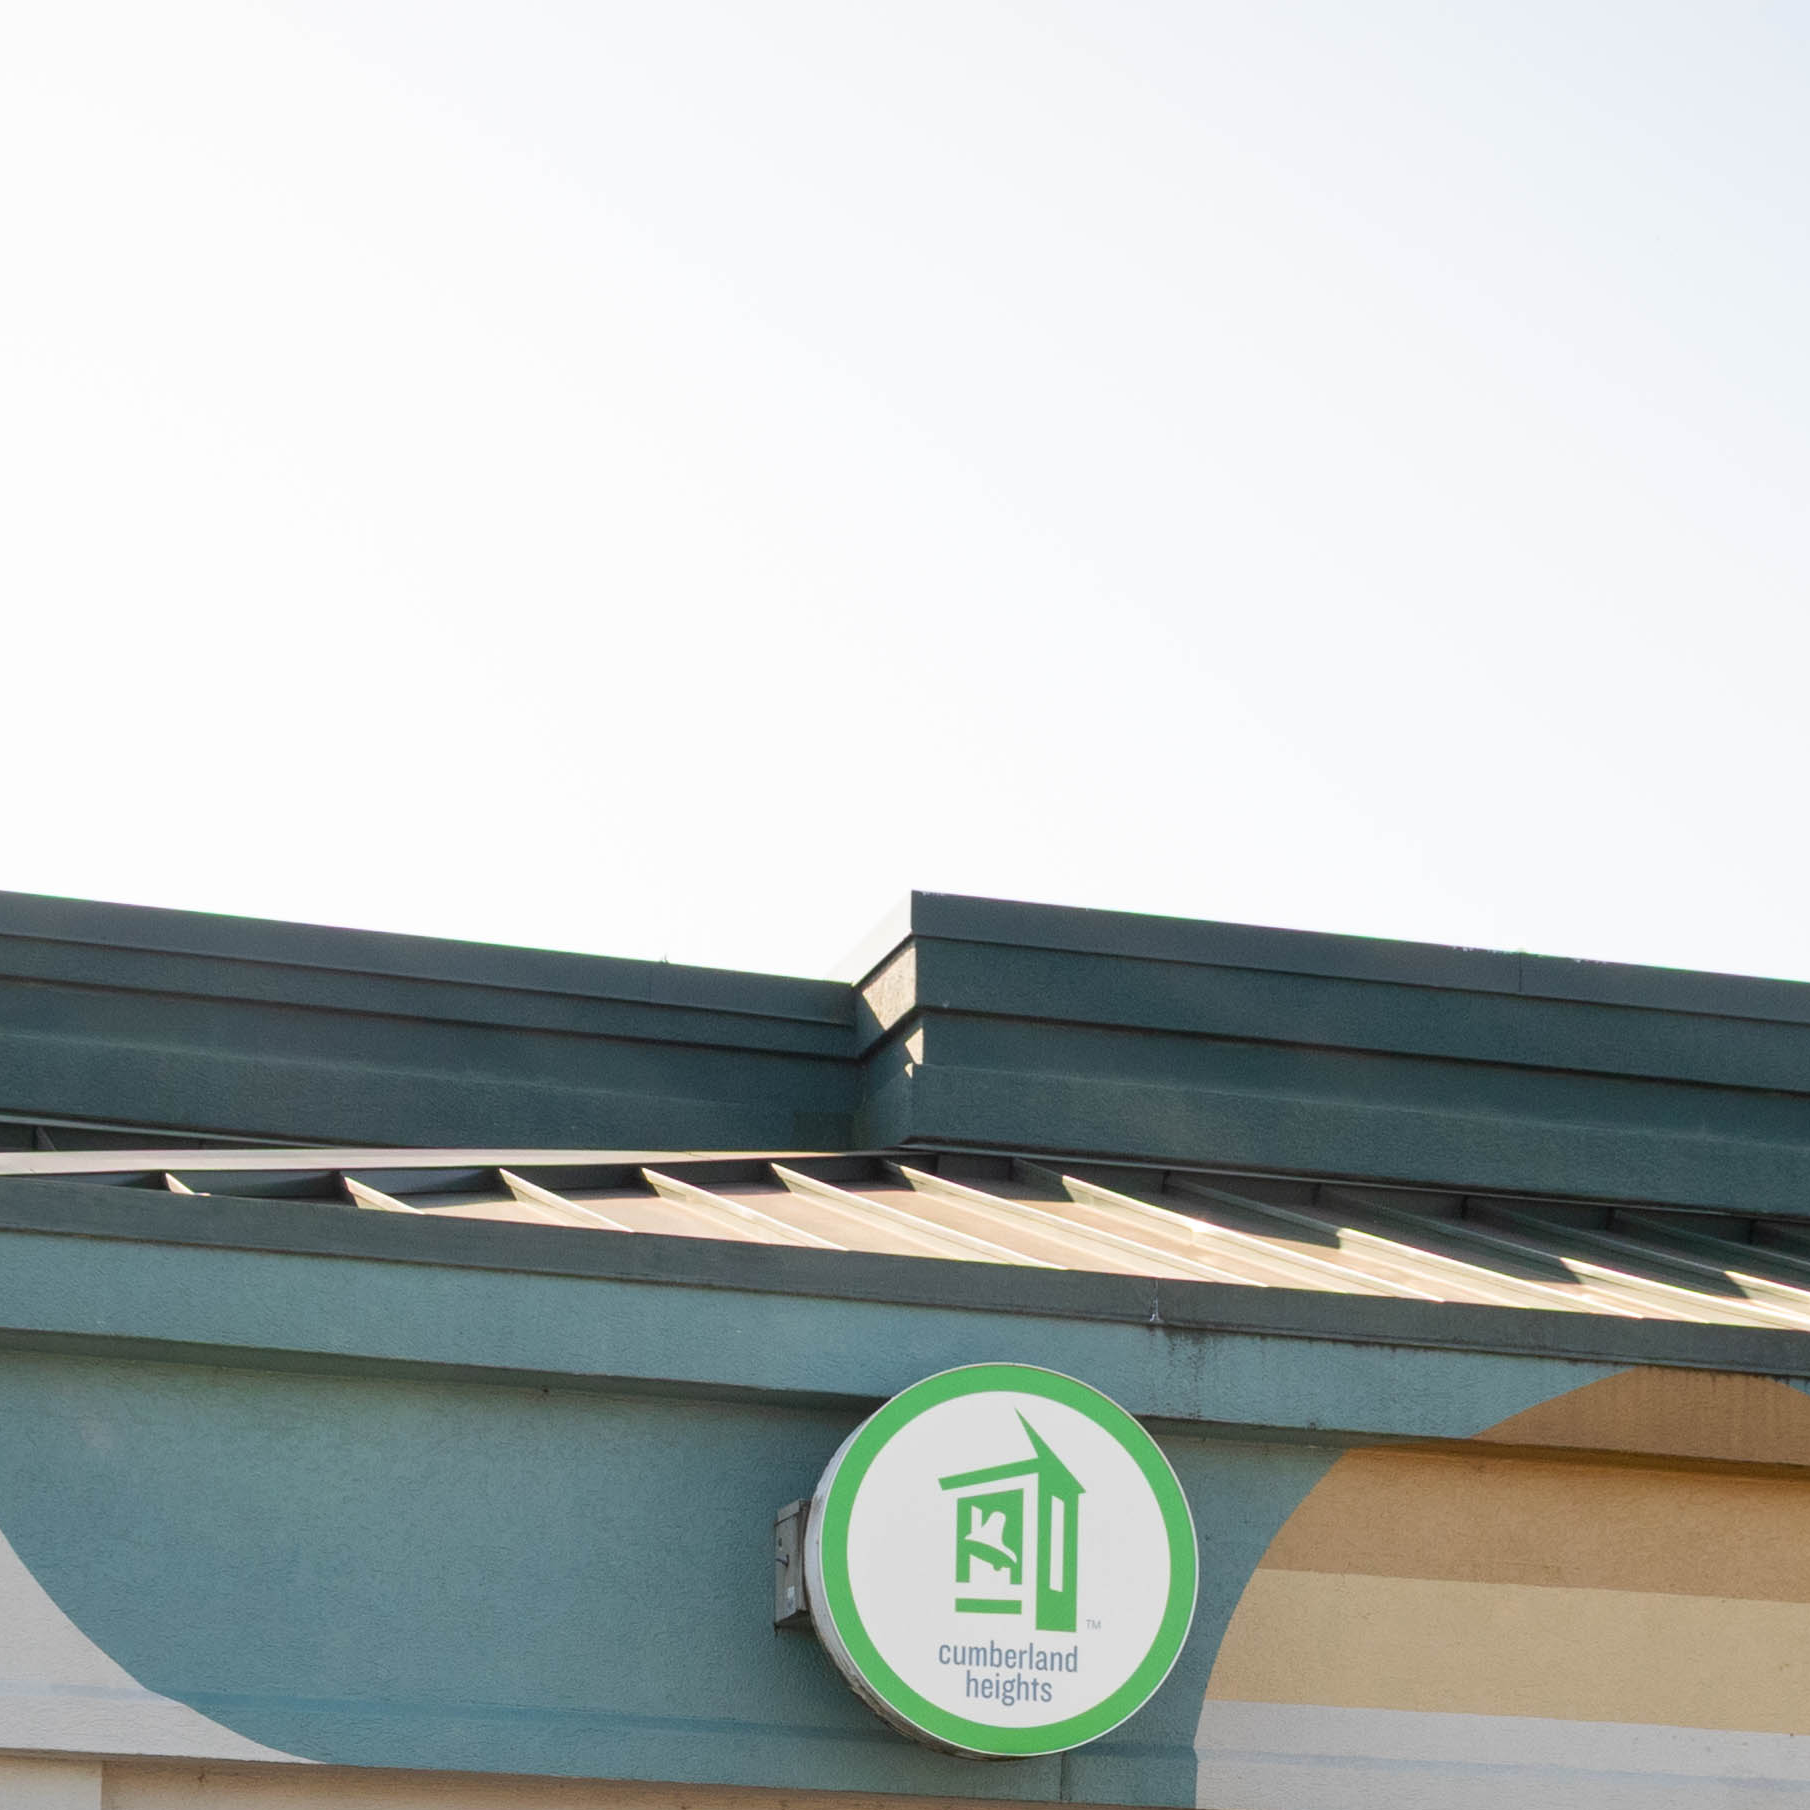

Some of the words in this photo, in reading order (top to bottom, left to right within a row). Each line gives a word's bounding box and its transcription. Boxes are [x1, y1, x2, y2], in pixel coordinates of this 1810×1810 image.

[1085, 1619, 1102, 1631] TM
[938, 1639, 1078, 1673] cumberland
[965, 1669, 1053, 1707] heights
